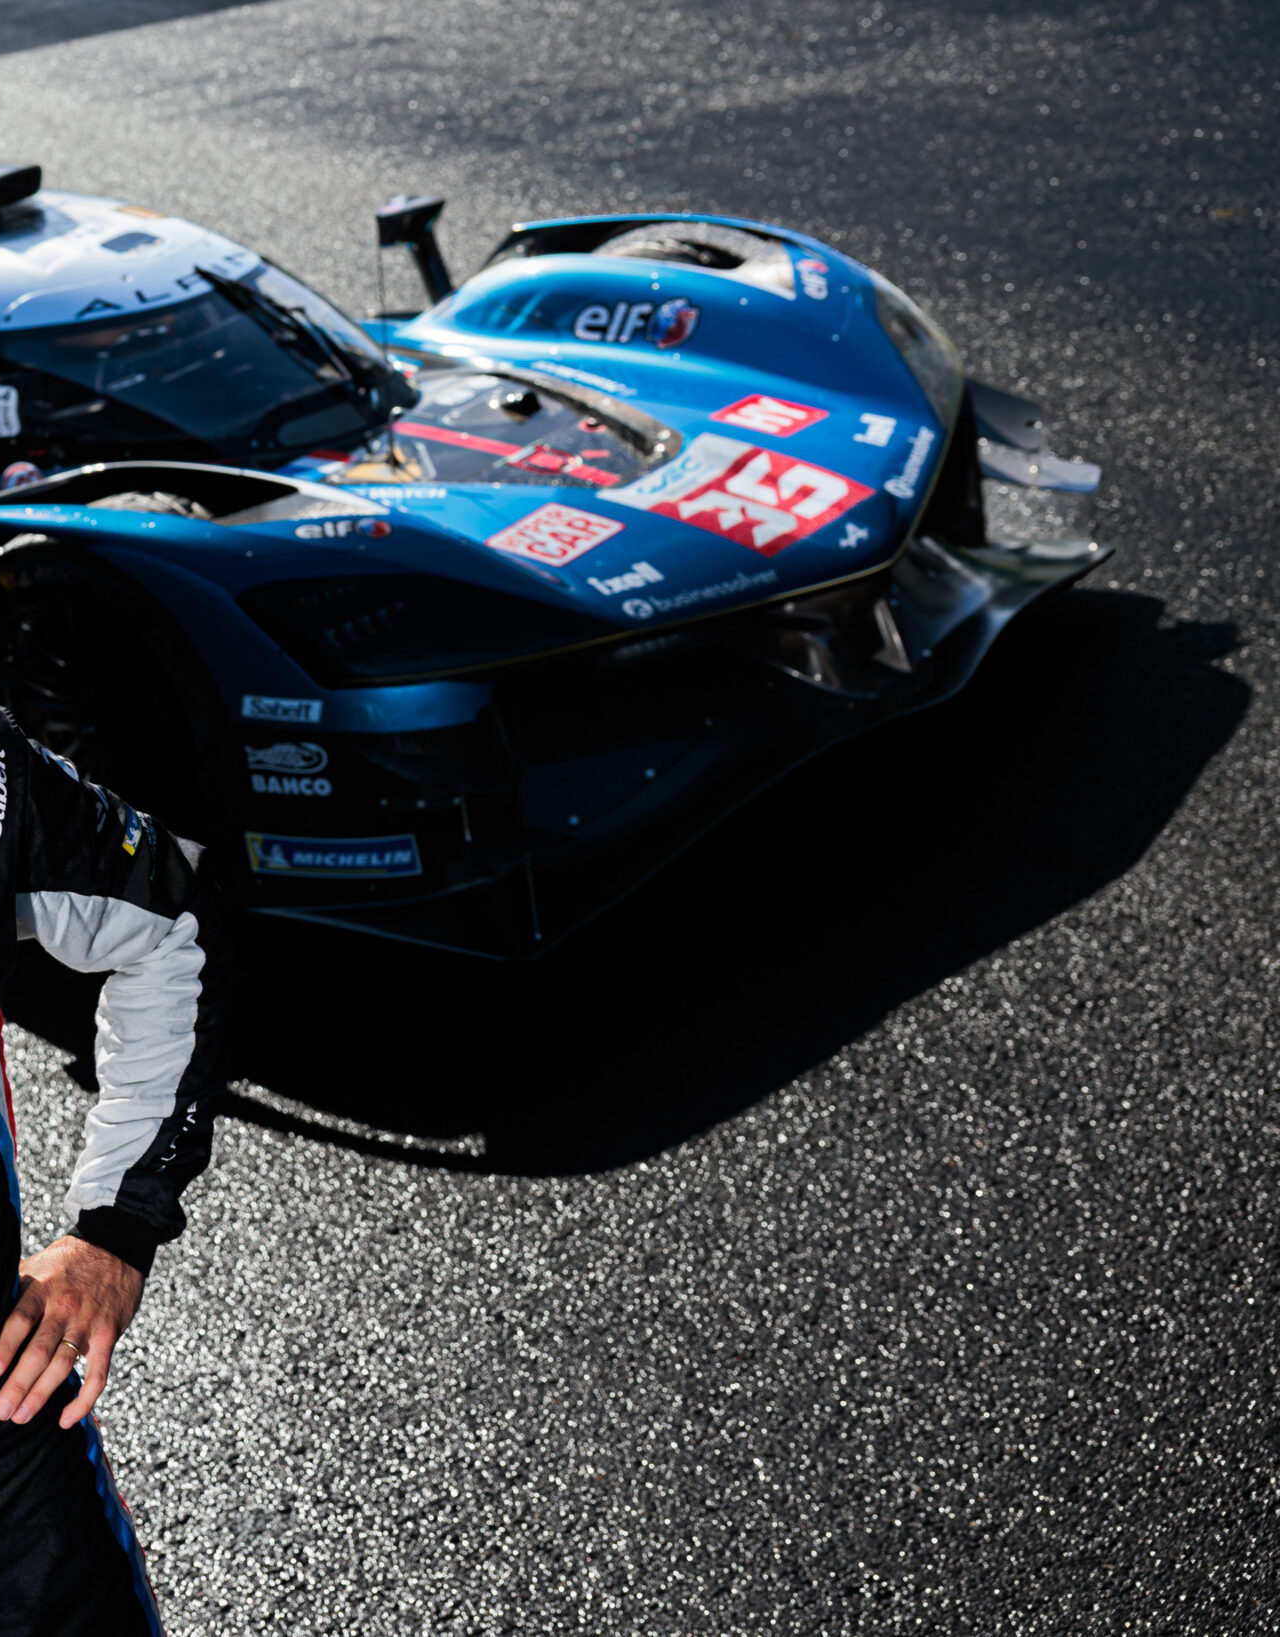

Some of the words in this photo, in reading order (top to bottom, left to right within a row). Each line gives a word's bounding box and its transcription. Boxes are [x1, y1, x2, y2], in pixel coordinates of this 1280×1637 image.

[574, 302, 653, 343] elf
[724, 396, 809, 433] HY
[677, 452, 849, 549] 35
[294, 520, 353, 539] elf
[526, 516, 611, 558] CAR
[250, 697, 313, 719] Sabelt
[251, 773, 332, 797] BAHCO
[292, 850, 413, 866] MICHELIN
